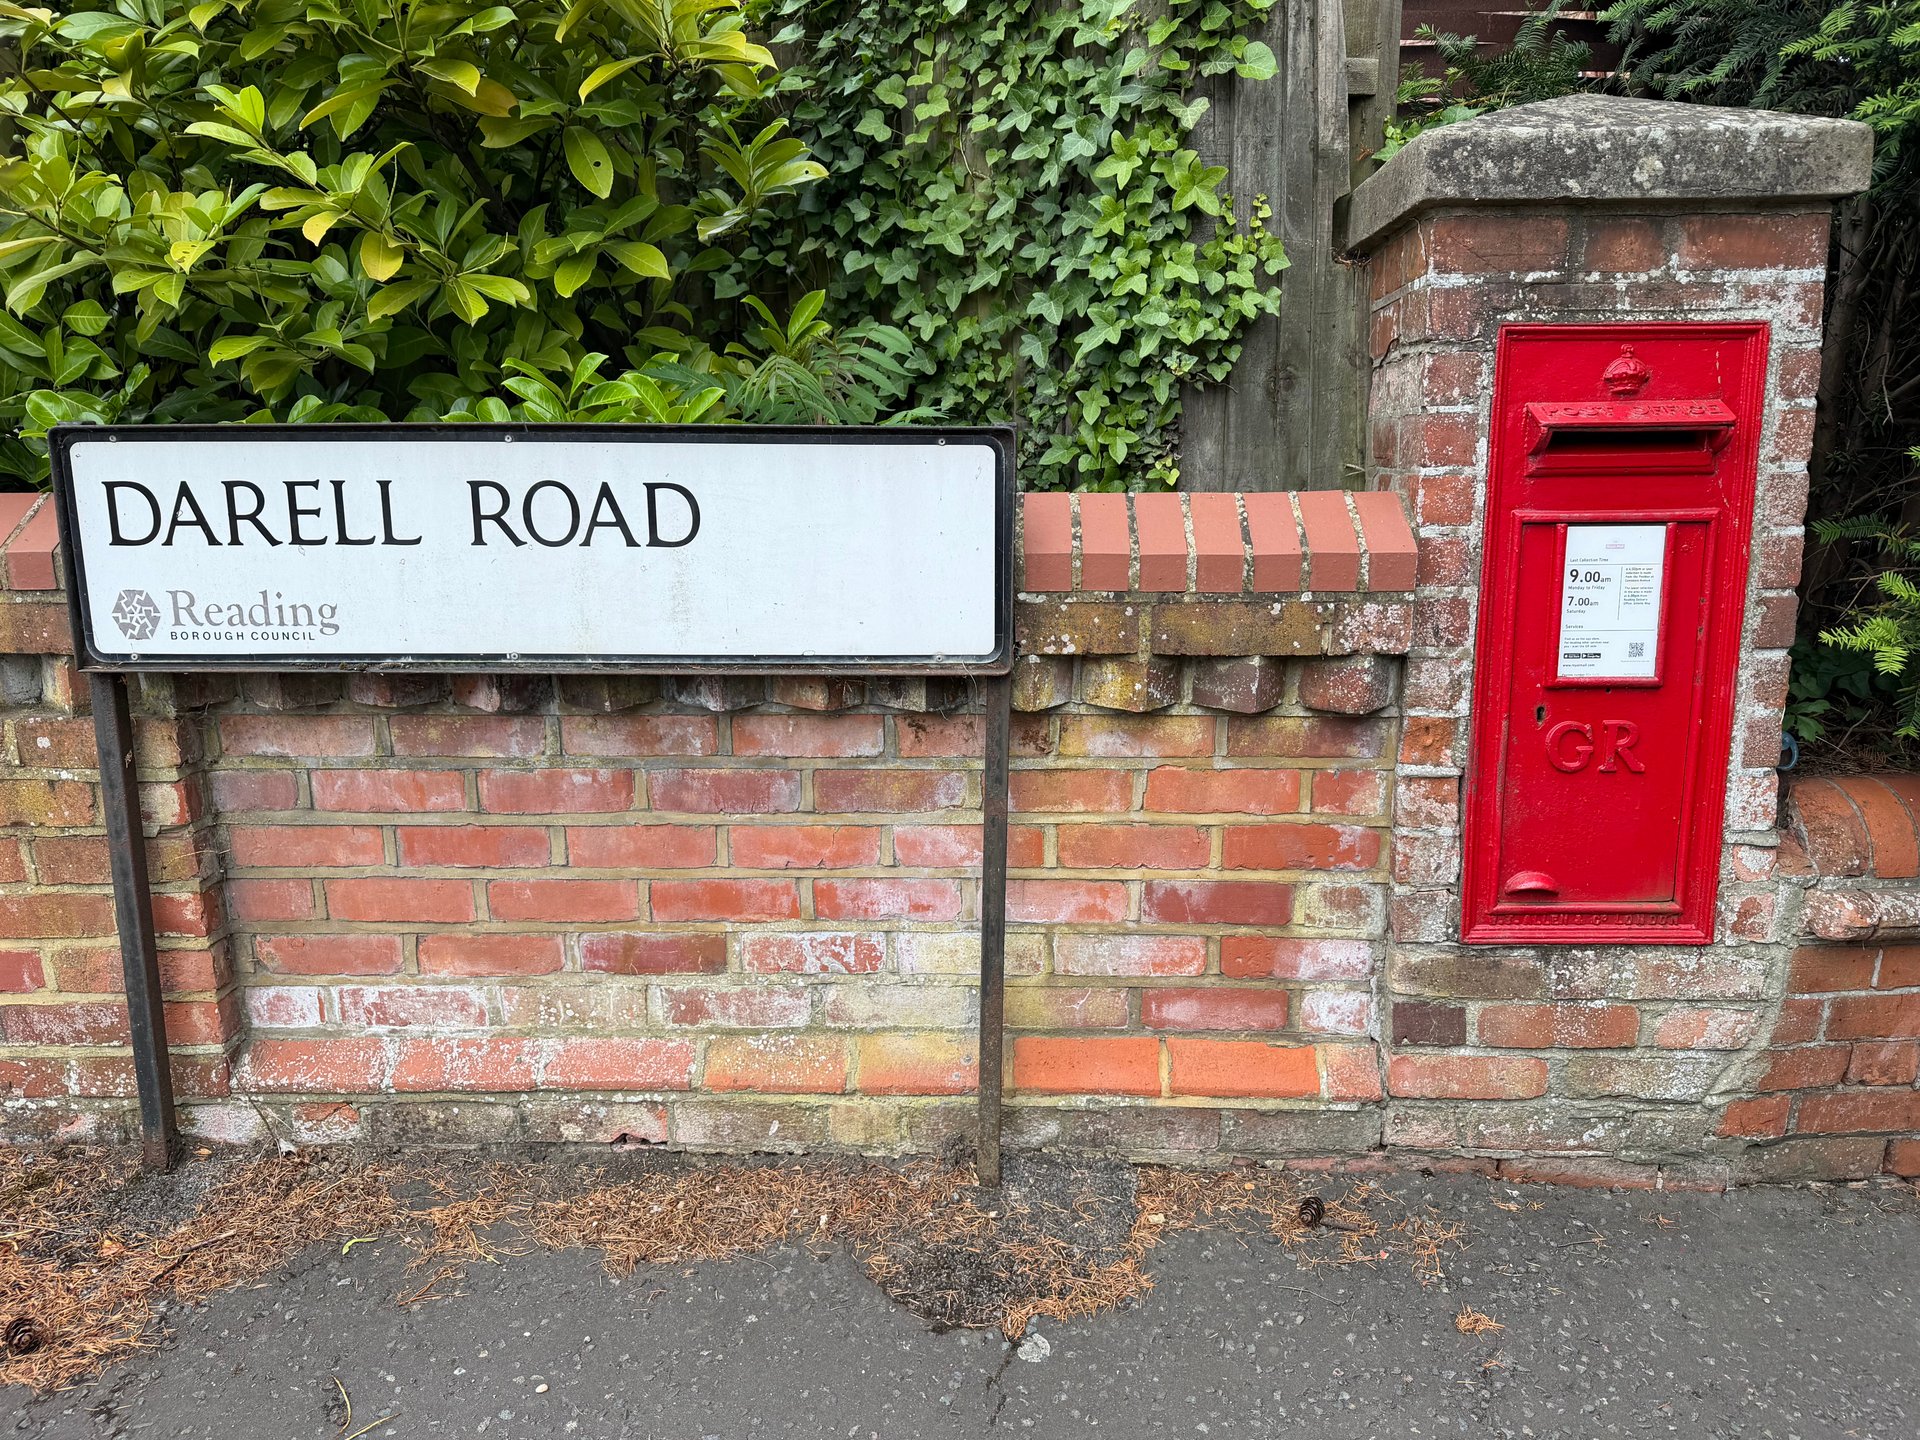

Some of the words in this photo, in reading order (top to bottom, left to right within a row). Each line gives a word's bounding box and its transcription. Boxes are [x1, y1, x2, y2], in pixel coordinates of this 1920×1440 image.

[101, 479, 422, 547] DARELL
[466, 479, 701, 547] ROAD
[1570, 568, 1611, 583] 9.00am
[166, 589, 340, 636] Reading
[1567, 595, 1599, 606] 7.00am
[170, 631, 245, 641] BOROUGH
[251, 631, 316, 641] COUNCIL
[1545, 719, 1646, 774] GR
